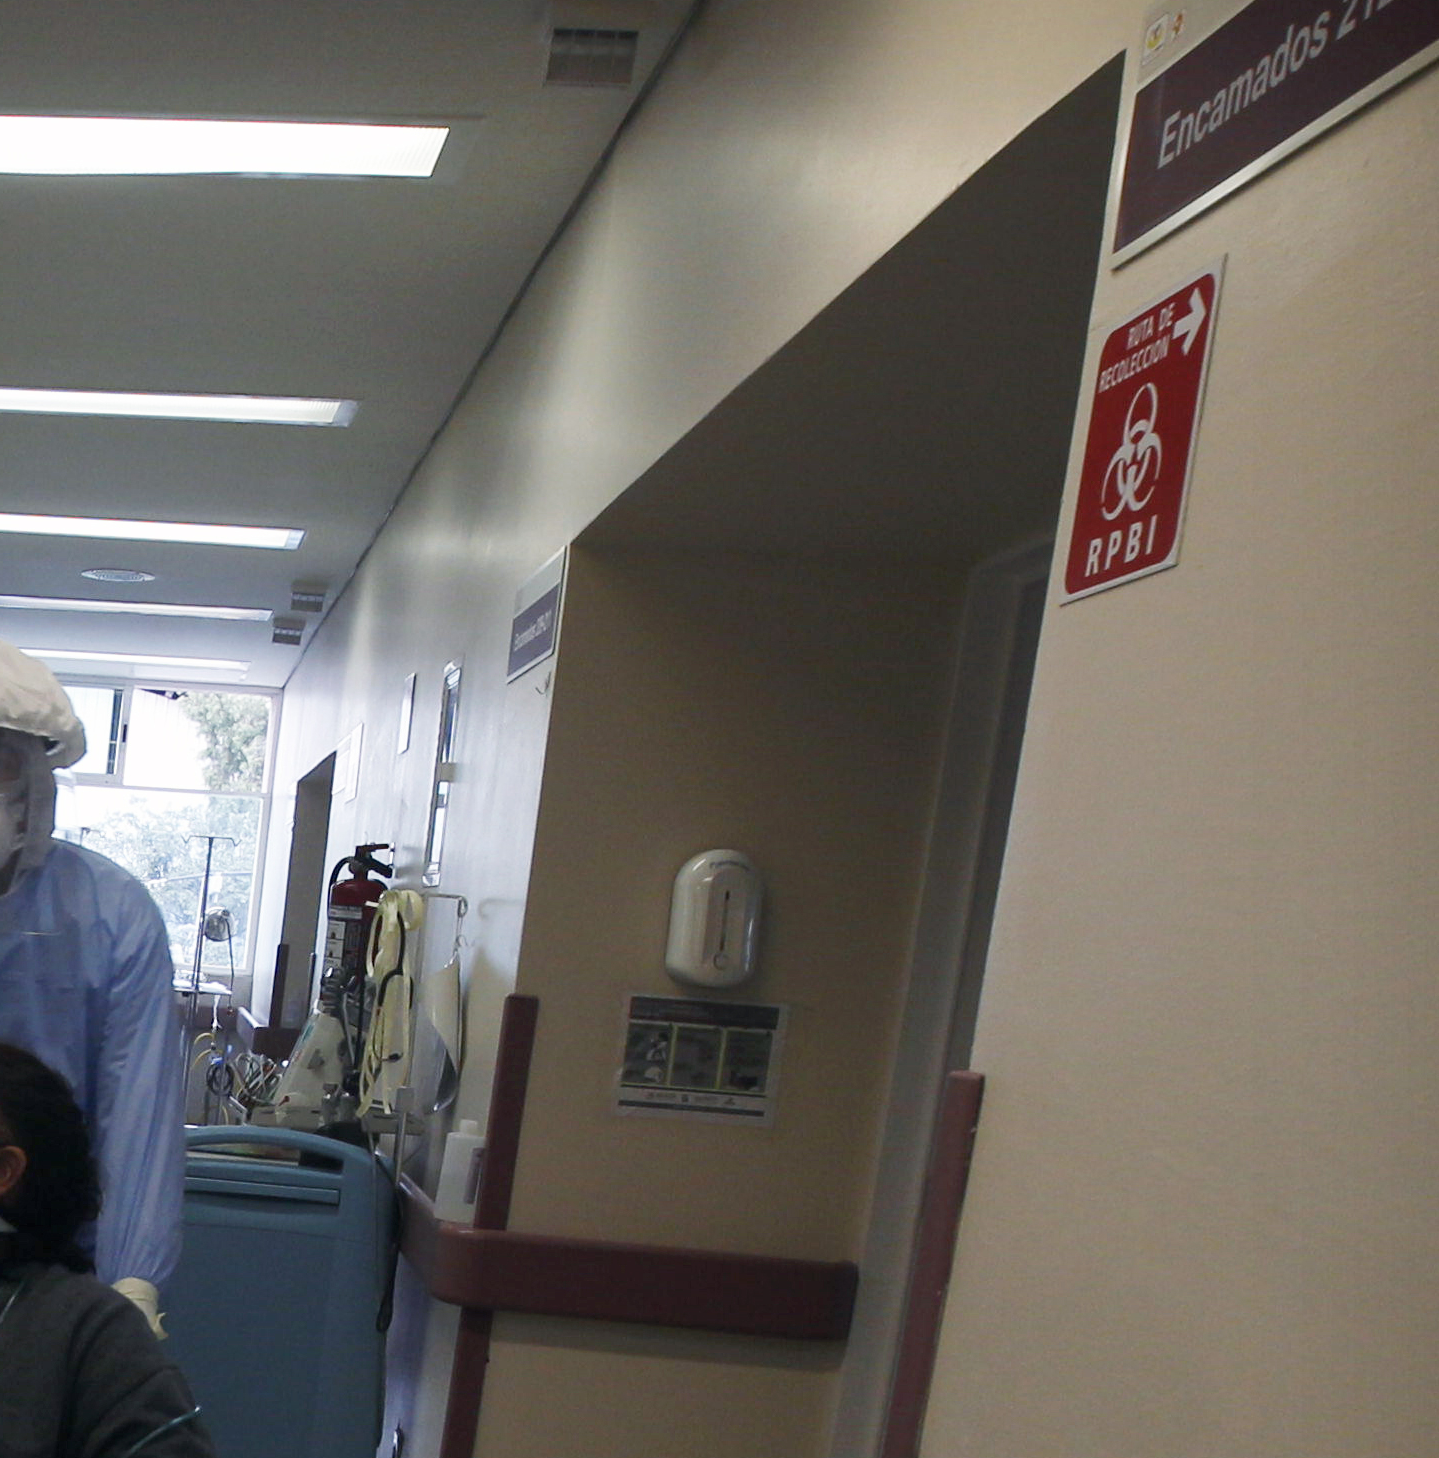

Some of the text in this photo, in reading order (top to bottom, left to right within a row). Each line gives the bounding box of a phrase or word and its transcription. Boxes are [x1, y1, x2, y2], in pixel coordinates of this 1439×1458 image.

[1157, 10, 1331, 170] Encamados
[1126, 302, 1176, 351] RUTA DE
[1084, 513, 1158, 578] RPBI
